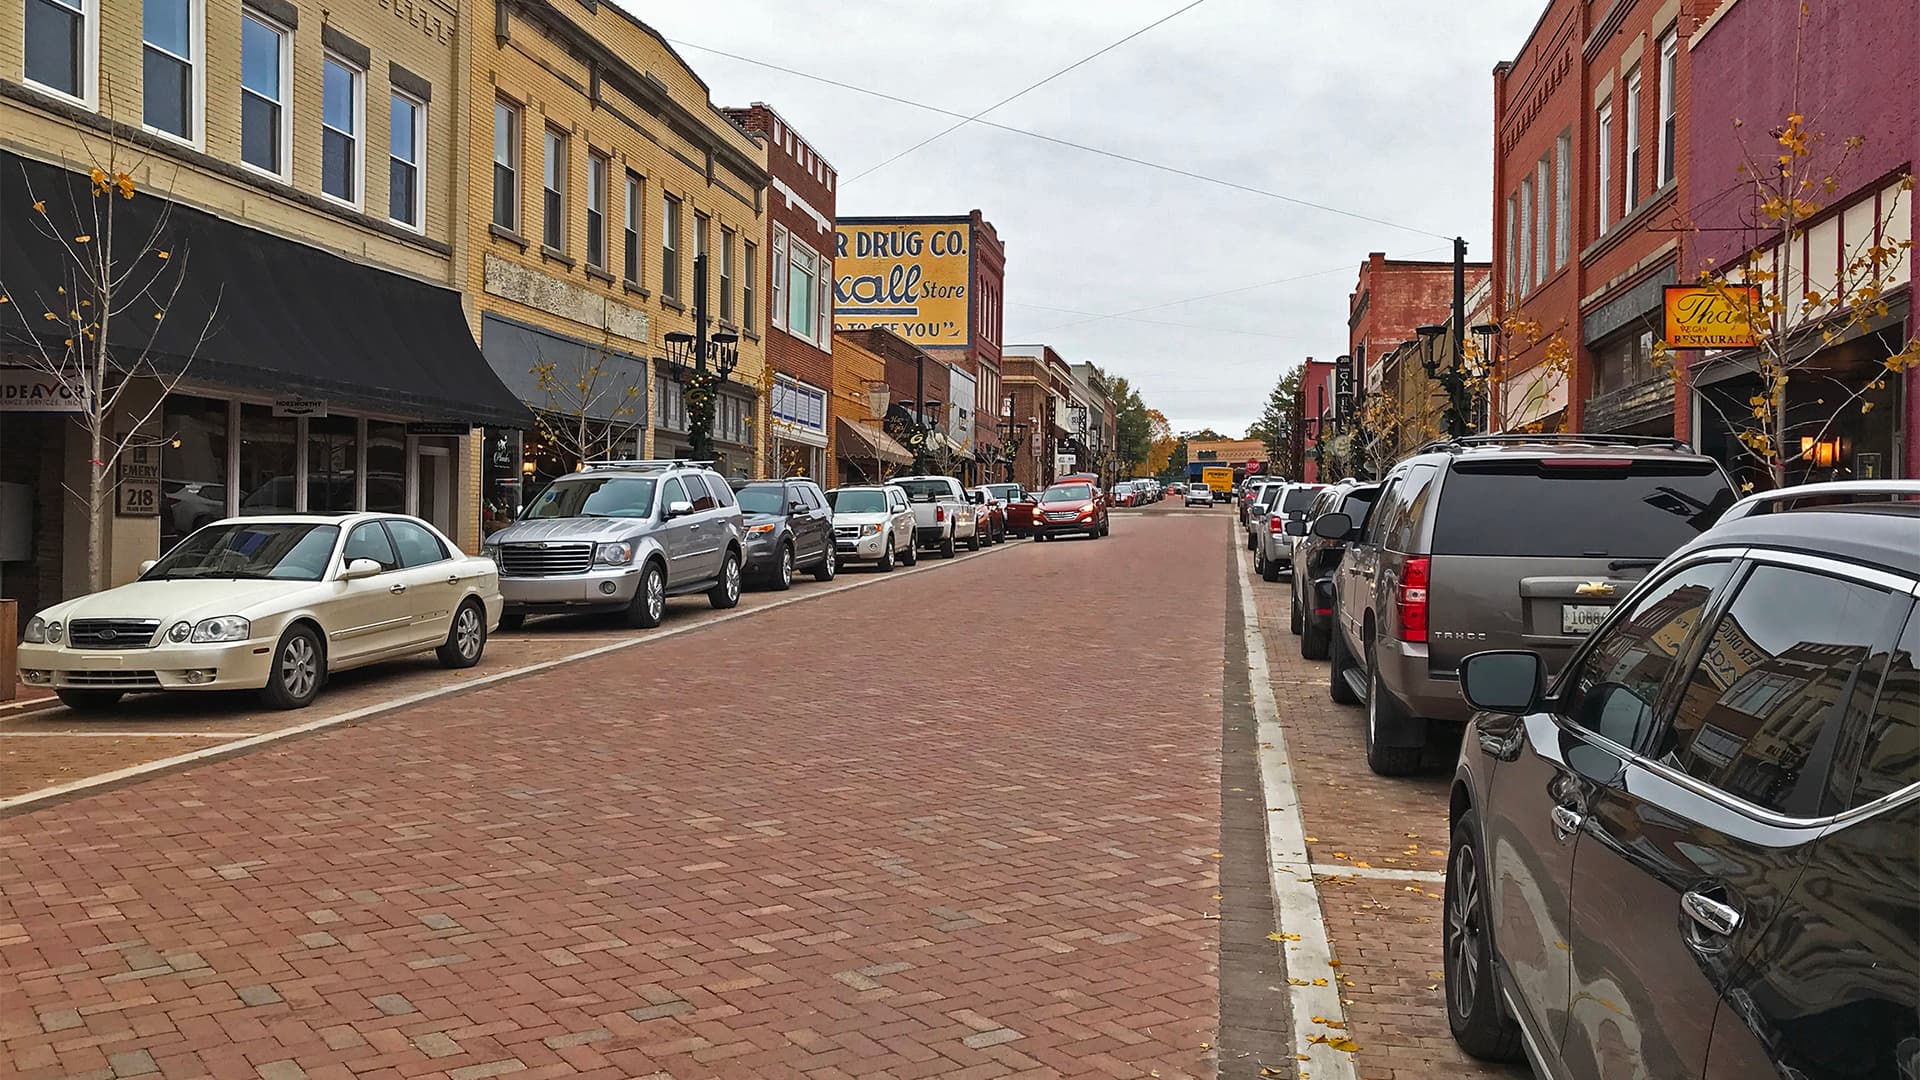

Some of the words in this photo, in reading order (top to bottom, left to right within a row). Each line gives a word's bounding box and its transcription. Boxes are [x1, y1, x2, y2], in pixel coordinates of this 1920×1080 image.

[856, 231, 924, 258] DRUG
[930, 230, 967, 257] CO.
[921, 281, 965, 299] Store
[123, 465, 158, 477] EMERY
[127, 489, 153, 506] 218
